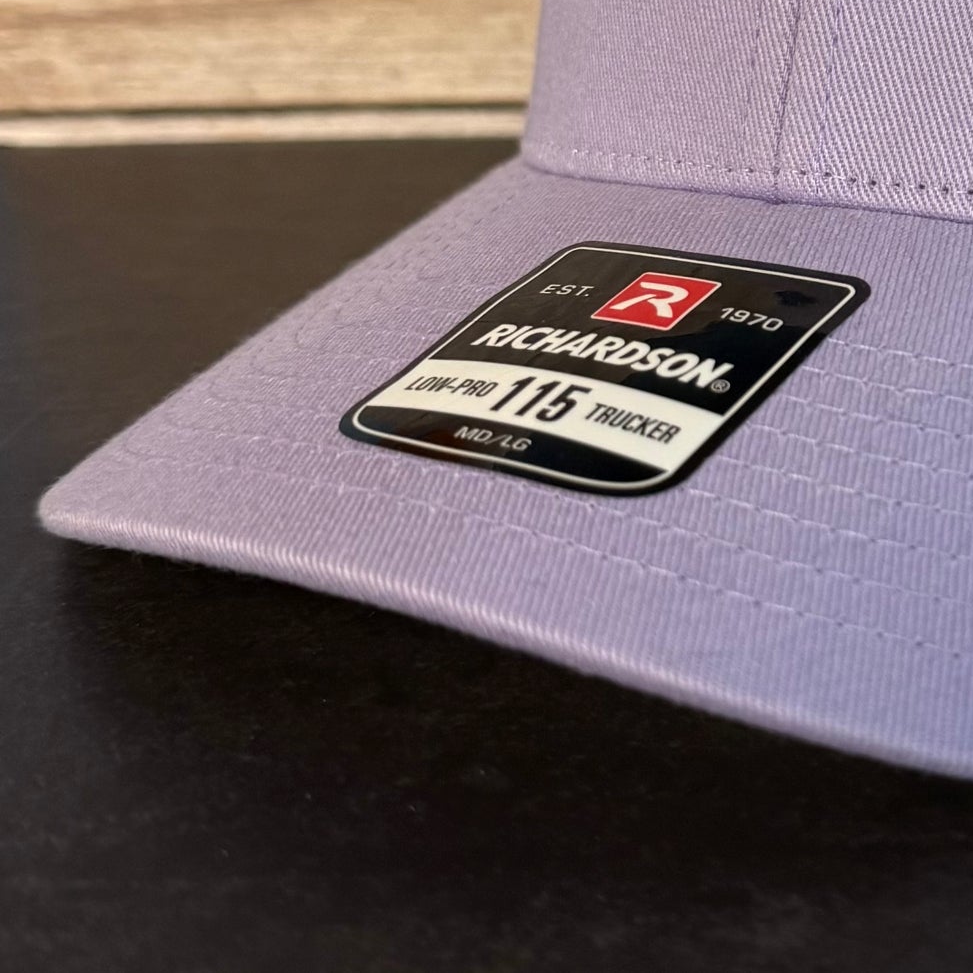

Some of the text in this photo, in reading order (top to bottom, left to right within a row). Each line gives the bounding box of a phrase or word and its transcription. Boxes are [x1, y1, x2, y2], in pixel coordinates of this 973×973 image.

[540, 282, 595, 298] EST.
[720, 306, 784, 333] 1970
[405, 375, 683, 446] LOW-PRO 115 TRUCKER
[453, 425, 532, 453] MD/LG
